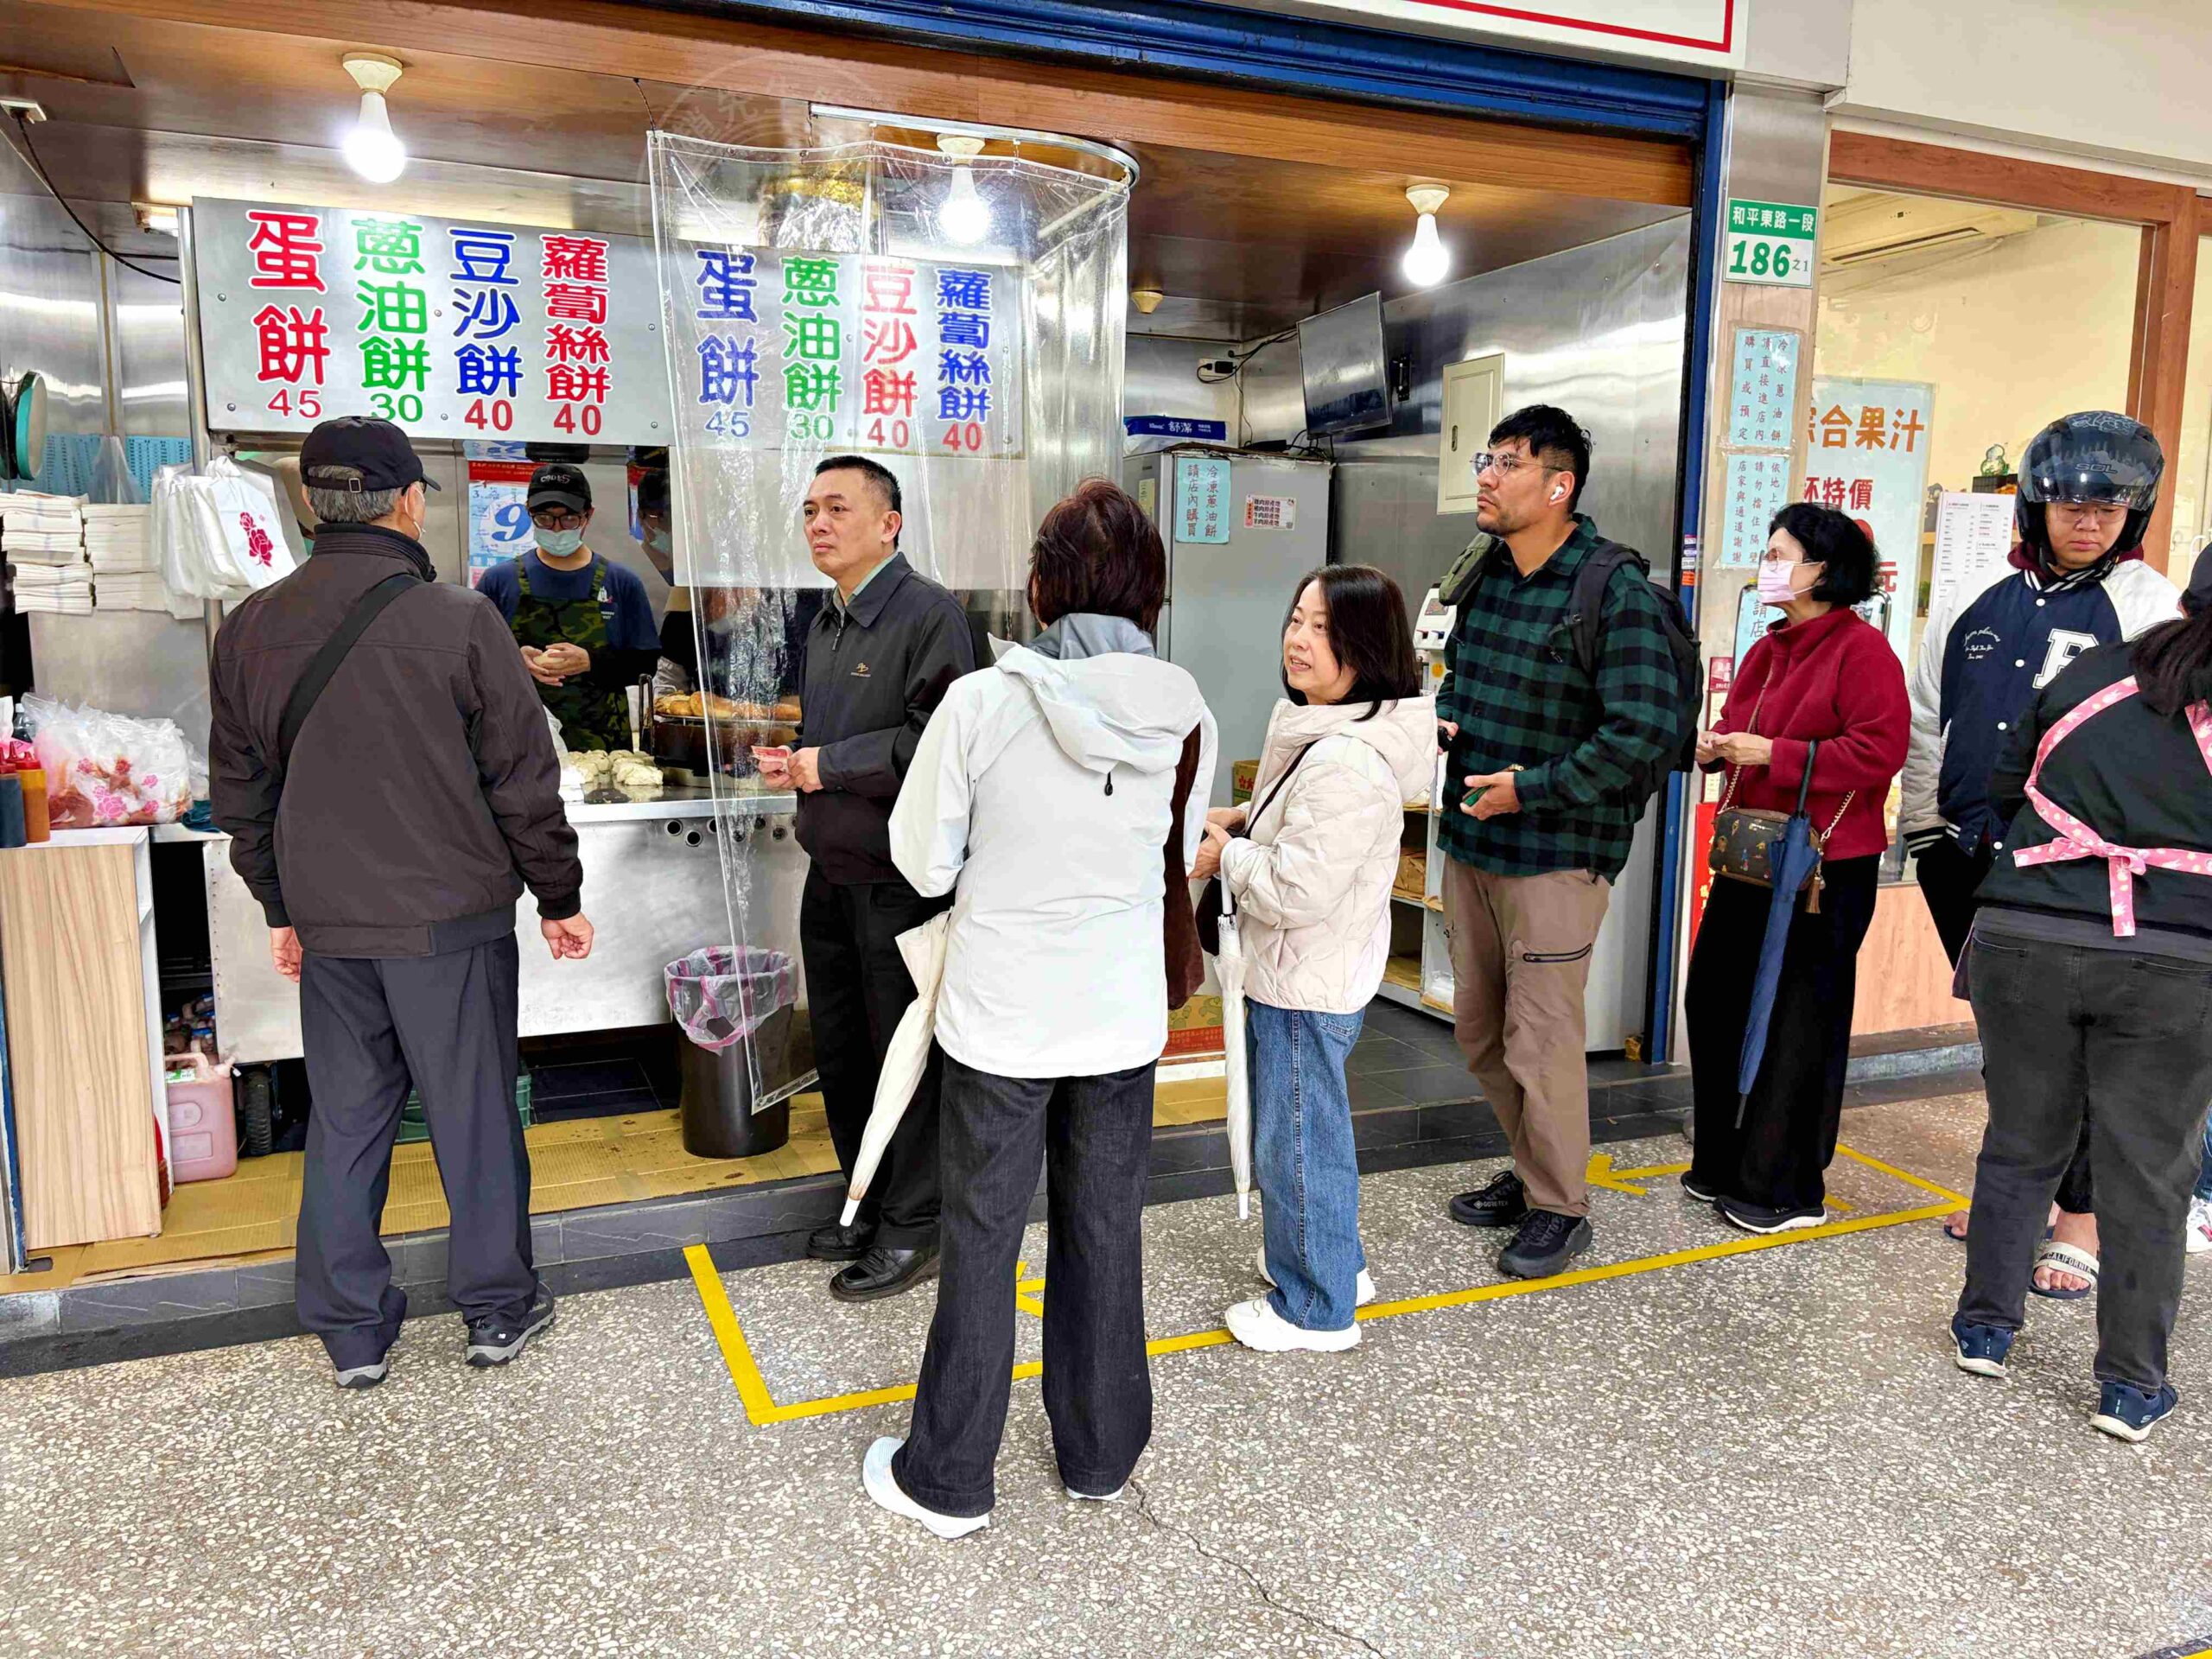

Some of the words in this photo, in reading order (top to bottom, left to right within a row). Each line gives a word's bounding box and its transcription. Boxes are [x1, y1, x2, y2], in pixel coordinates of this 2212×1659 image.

[1732, 207, 1815, 232] 和平東路一段
[1730, 240, 1791, 277] 186
[248, 211, 331, 385] 蛋餅
[352, 219, 432, 392] 蔥油餅
[451, 229, 524, 397] 豆沙餅
[542, 236, 611, 404] 蘿蔔絲餅
[695, 251, 760, 406] 蛋餅
[780, 256, 842, 413] 蔥油餅
[862, 264, 918, 418] 豆沙餅
[937, 269, 992, 422] 蘿蔔絲餅
[268, 389, 321, 418] 45
[1737, 334, 1757, 441] 購買或預定
[370, 393, 423, 423] 30
[464, 398, 513, 431] 40
[553, 404, 601, 435] 40
[704, 410, 752, 439] 45
[789, 413, 835, 441] 30
[1168, 420, 1193, 434] 舒潔
[867, 417, 910, 448] 40
[942, 422, 982, 452] 40
[1808, 404, 1925, 454] 合果汁
[2075, 462, 2119, 474] SOL
[1185, 463, 1200, 537] 請店內購買
[491, 503, 533, 542] 9
[1750, 599, 1768, 641] 請店
[2046, 1251, 2092, 1274] CALIFORNIA
